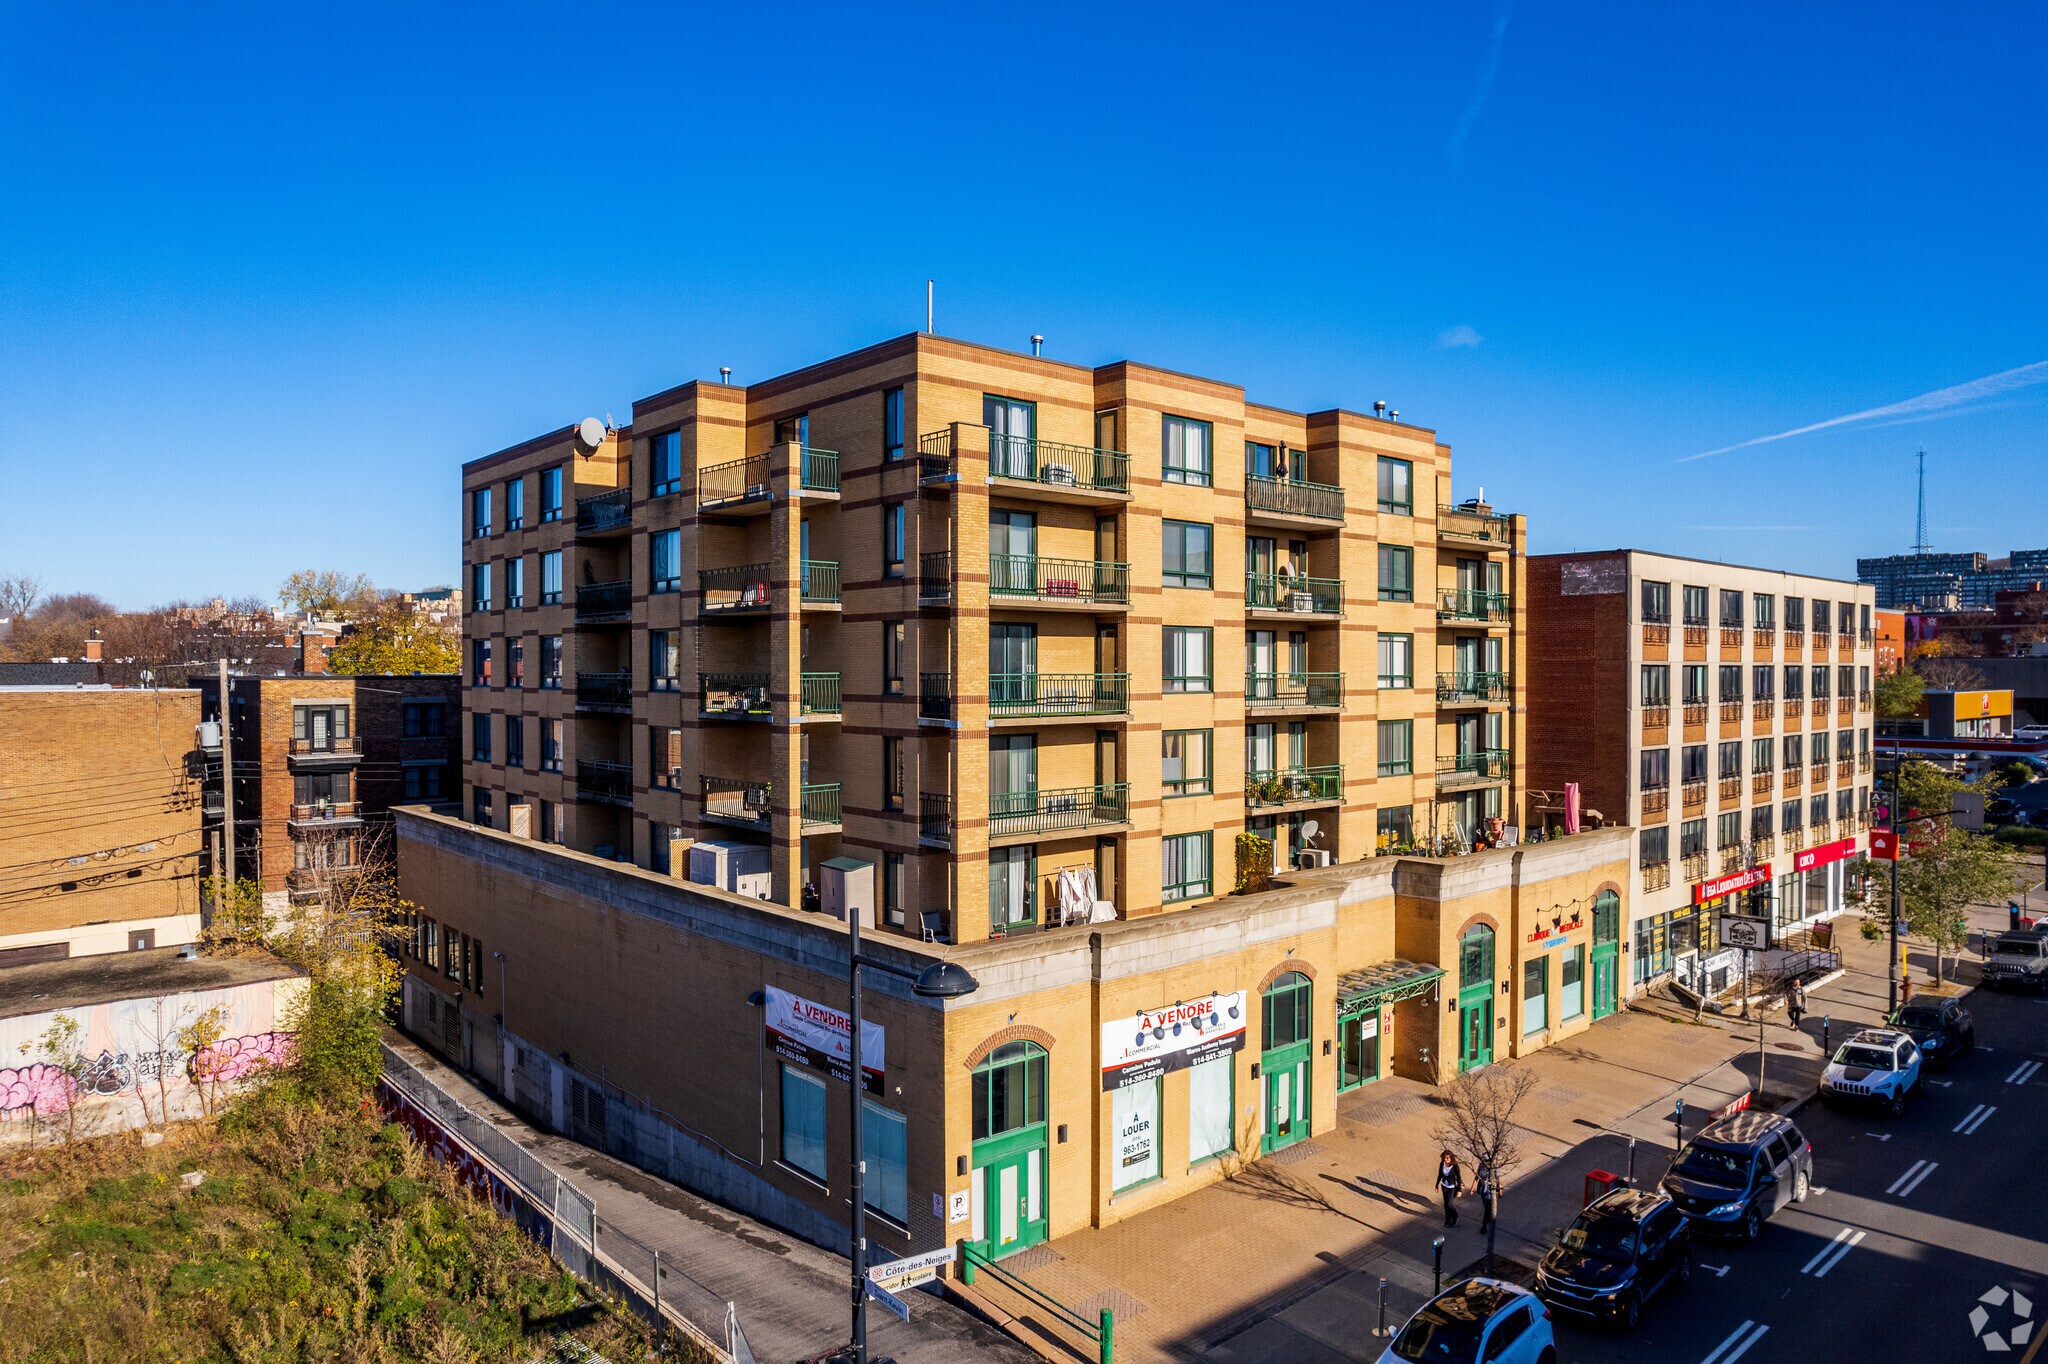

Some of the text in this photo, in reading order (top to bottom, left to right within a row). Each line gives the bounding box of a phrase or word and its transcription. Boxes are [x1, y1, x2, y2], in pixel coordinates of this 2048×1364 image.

[1528, 929, 1551, 943] CLINIQUE
[793, 996, 851, 1031] À VENDRE
[1158, 1001, 1213, 1025] VENDRE
[1129, 1043, 1161, 1057] COMMERCIAL
[1187, 1047, 1201, 1055] Marco
[1202, 1041, 1219, 1053] Anthony
[1219, 1036, 1236, 1046] Romano
[1123, 1121, 1150, 1137] LOUER
[1123, 1138, 1150, 1155] 963-1762
[885, 1253, 951, 1277] Côte-des-Neiges
[913, 1271, 932, 1282] scolaire
